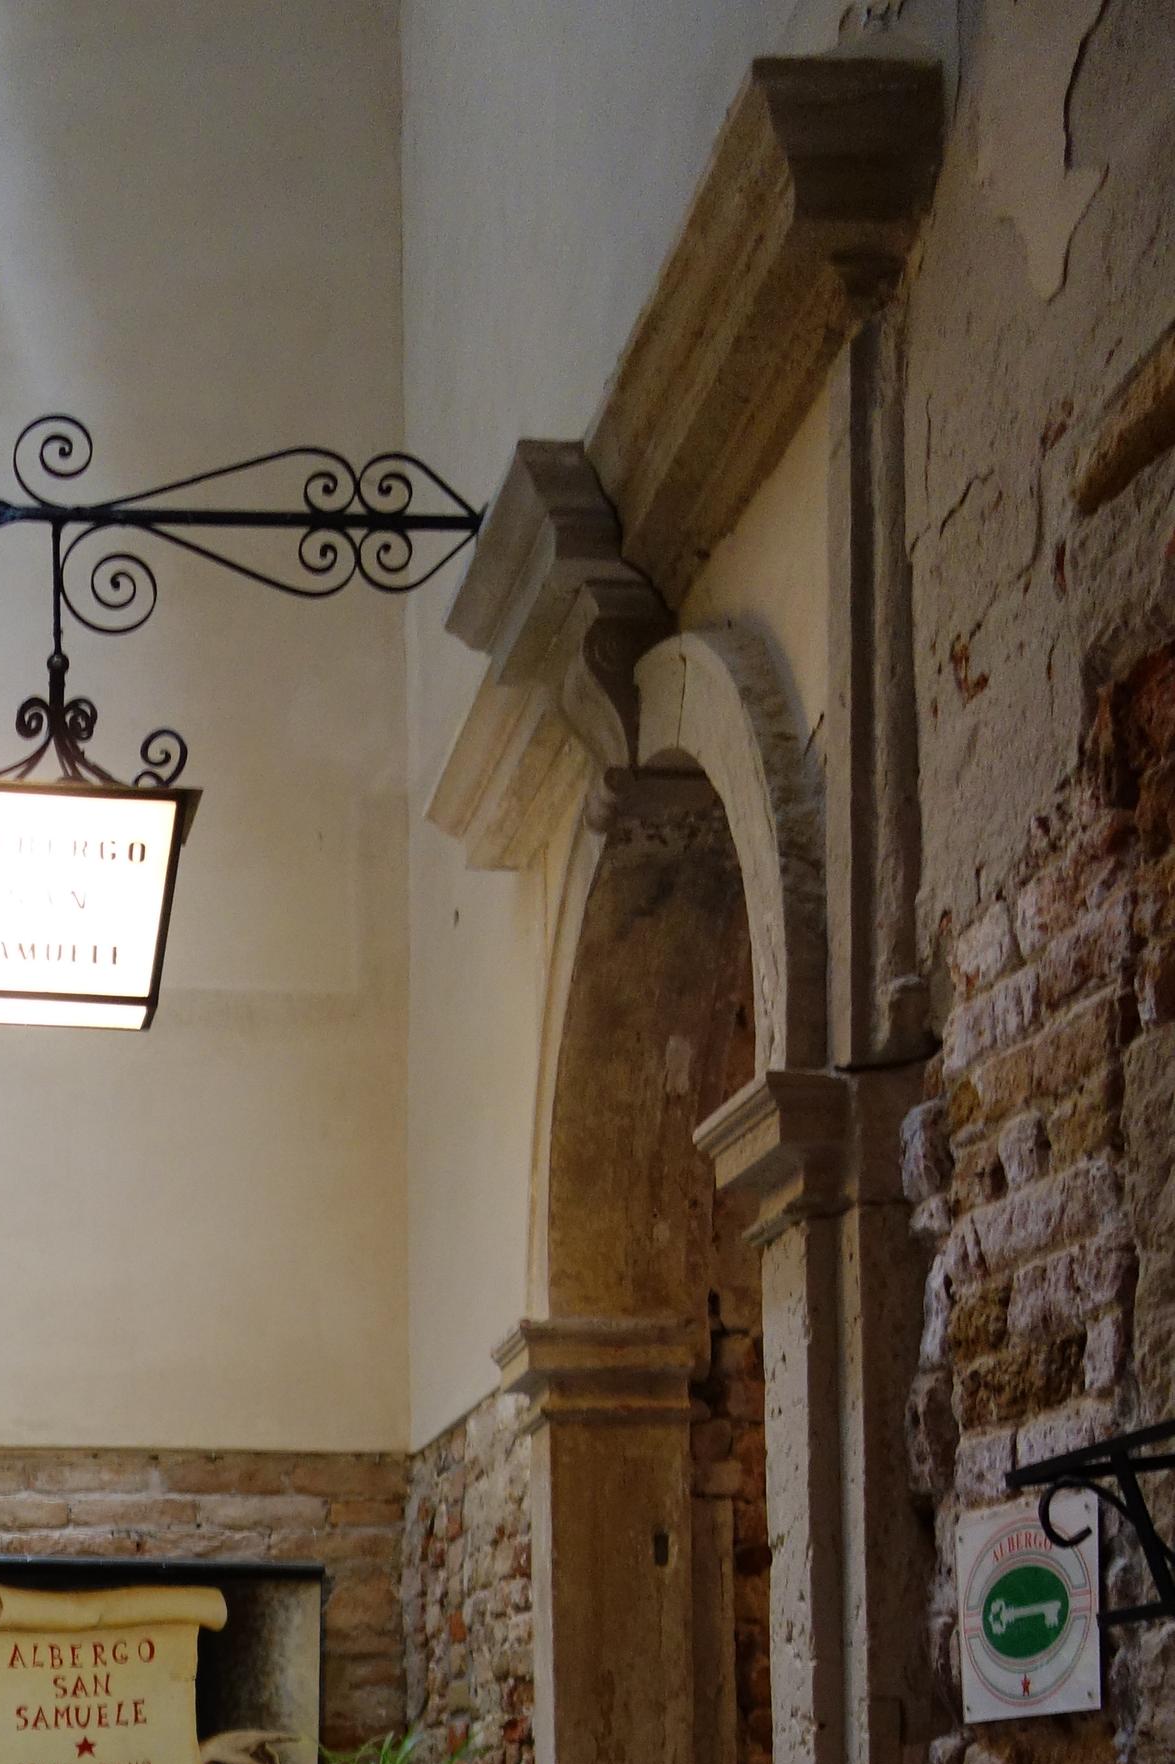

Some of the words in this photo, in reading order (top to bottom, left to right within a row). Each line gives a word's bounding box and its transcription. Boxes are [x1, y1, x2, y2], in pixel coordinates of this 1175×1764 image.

[993, 1530, 1053, 1562] ALBERGO
[7, 1638, 157, 1670] ALBERGO
[52, 1673, 113, 1700] SAN
[15, 1698, 148, 1731] SAMUELE
